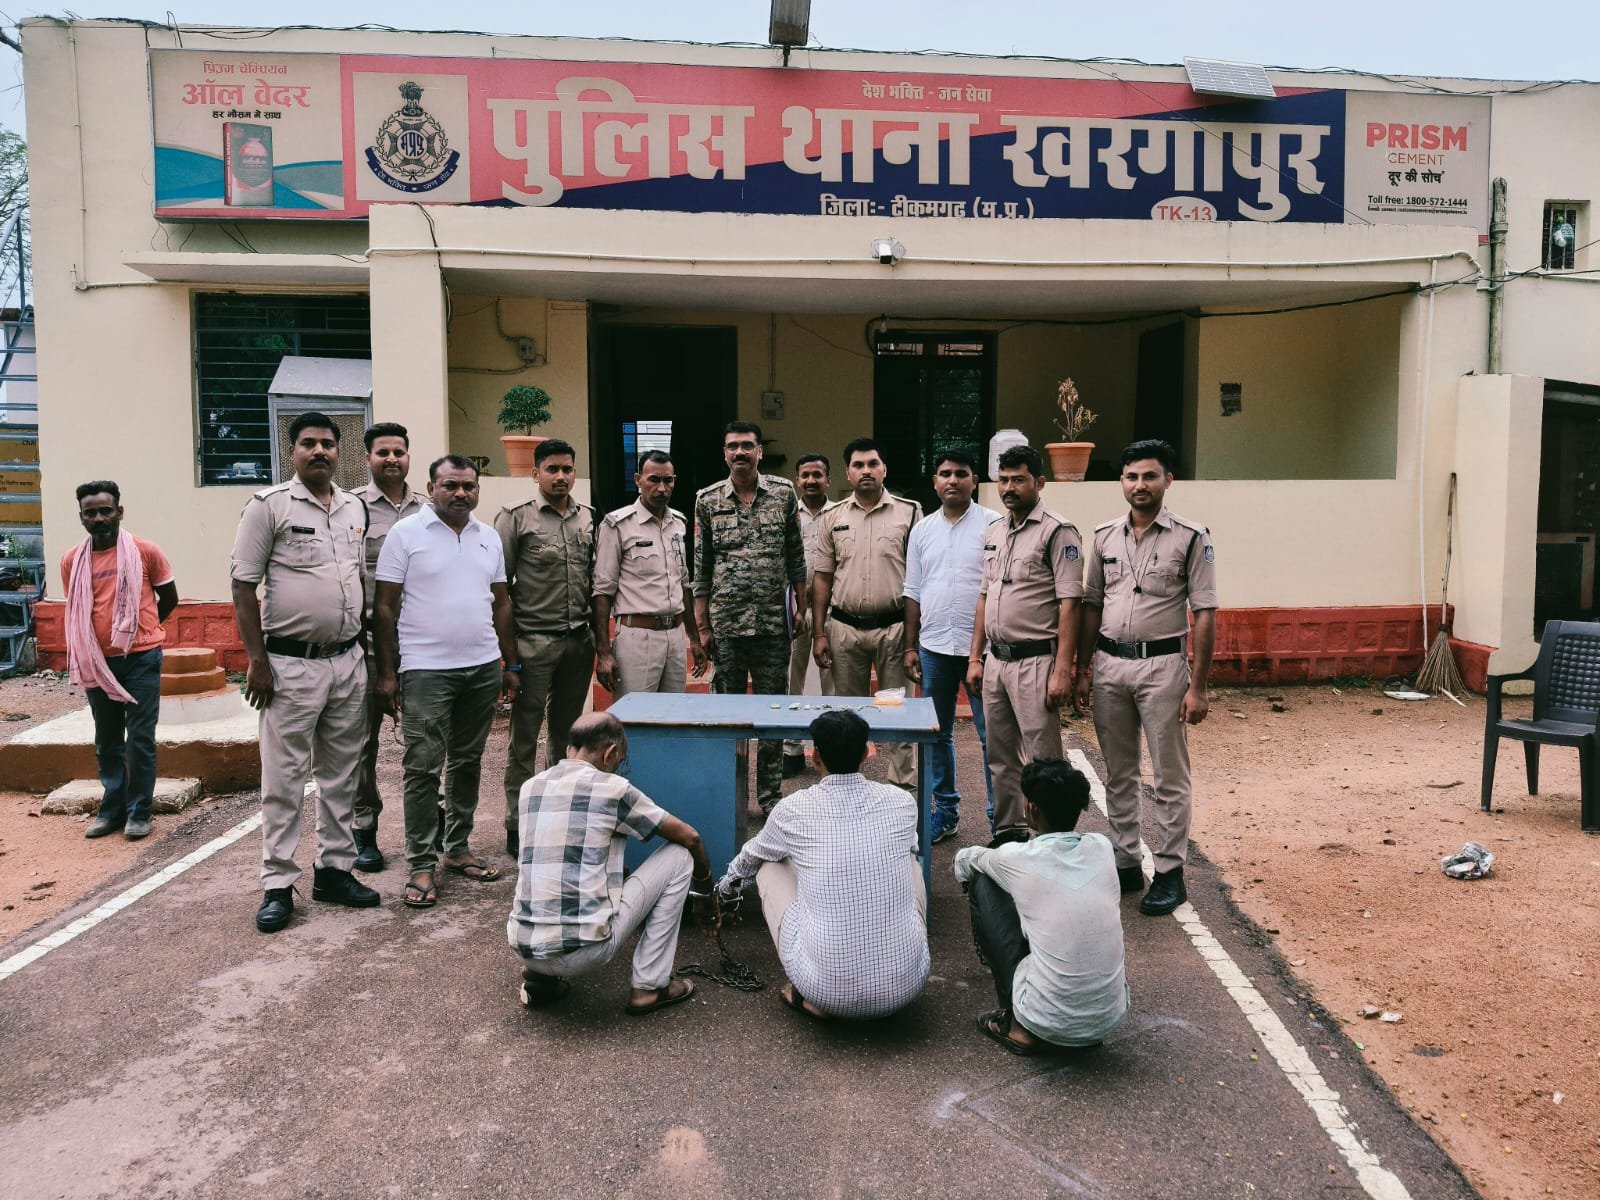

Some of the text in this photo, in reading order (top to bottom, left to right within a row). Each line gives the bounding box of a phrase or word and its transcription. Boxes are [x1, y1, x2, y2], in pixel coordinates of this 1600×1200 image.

[182, 79, 311, 107] ऑल वेदर
[862, 80, 885, 98] देश
[889, 81, 925, 100] भक्ति
[938, 87, 963, 101] जन
[965, 84, 993, 102] सेवा
[1366, 122, 1468, 152] PRISM
[486, 76, 1332, 222] पुलिस थाना खरगापुर
[1388, 153, 1445, 165] CEMENT
[1388, 171, 1402, 187] दूर
[1405, 168, 1418, 183] की
[1368, 195, 1468, 207] Toll free: 1800-572-1444
[1156, 205, 1212, 221] TK-13
